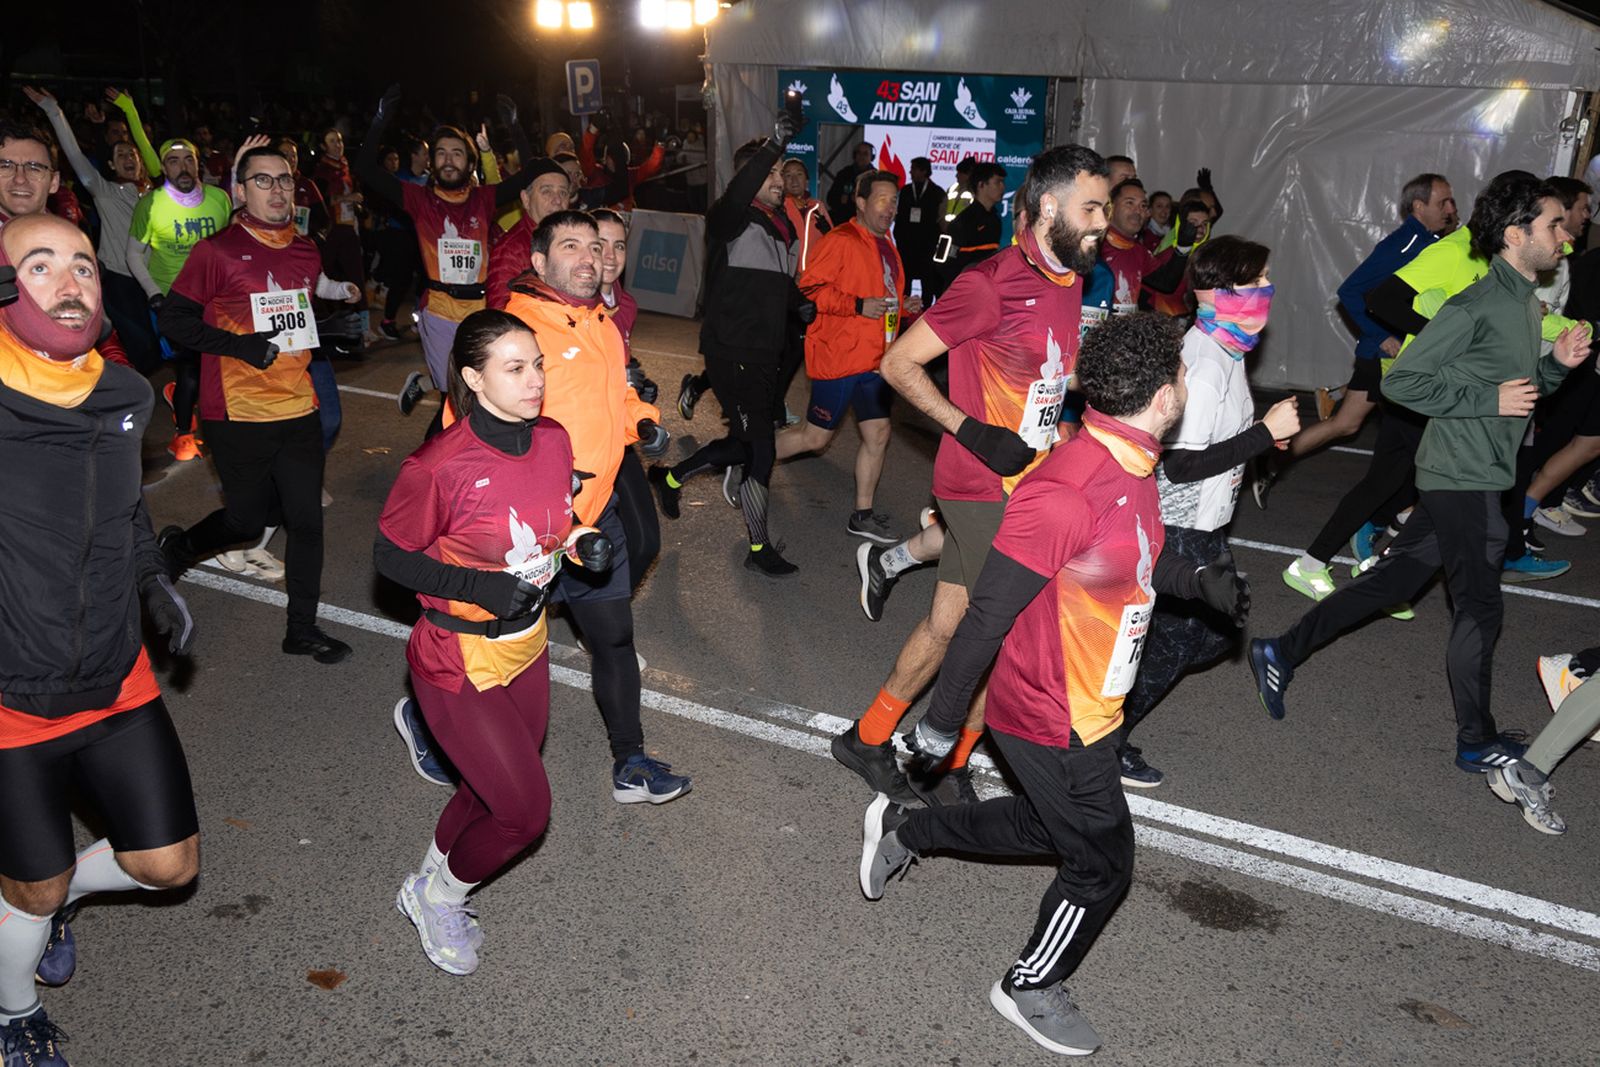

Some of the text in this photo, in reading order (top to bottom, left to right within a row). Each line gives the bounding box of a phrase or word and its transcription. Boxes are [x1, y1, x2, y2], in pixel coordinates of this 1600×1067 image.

[575, 67, 594, 108] P
[876, 80, 941, 102] 43 SAN
[836, 100, 848, 115] 43
[870, 97, 936, 123] ANTÓN
[963, 105, 976, 121] 43
[785, 142, 814, 152] alderón
[928, 149, 960, 165] SAN
[449, 254, 476, 269] 1816
[641, 252, 678, 272] alsa
[260, 305, 275, 314] SAN
[275, 303, 295, 313] ANTÓN
[268, 298, 285, 306] NOCHE
[286, 296, 293, 304] DE
[268, 311, 306, 331] 1308
[1034, 396, 1048, 405] SAN
